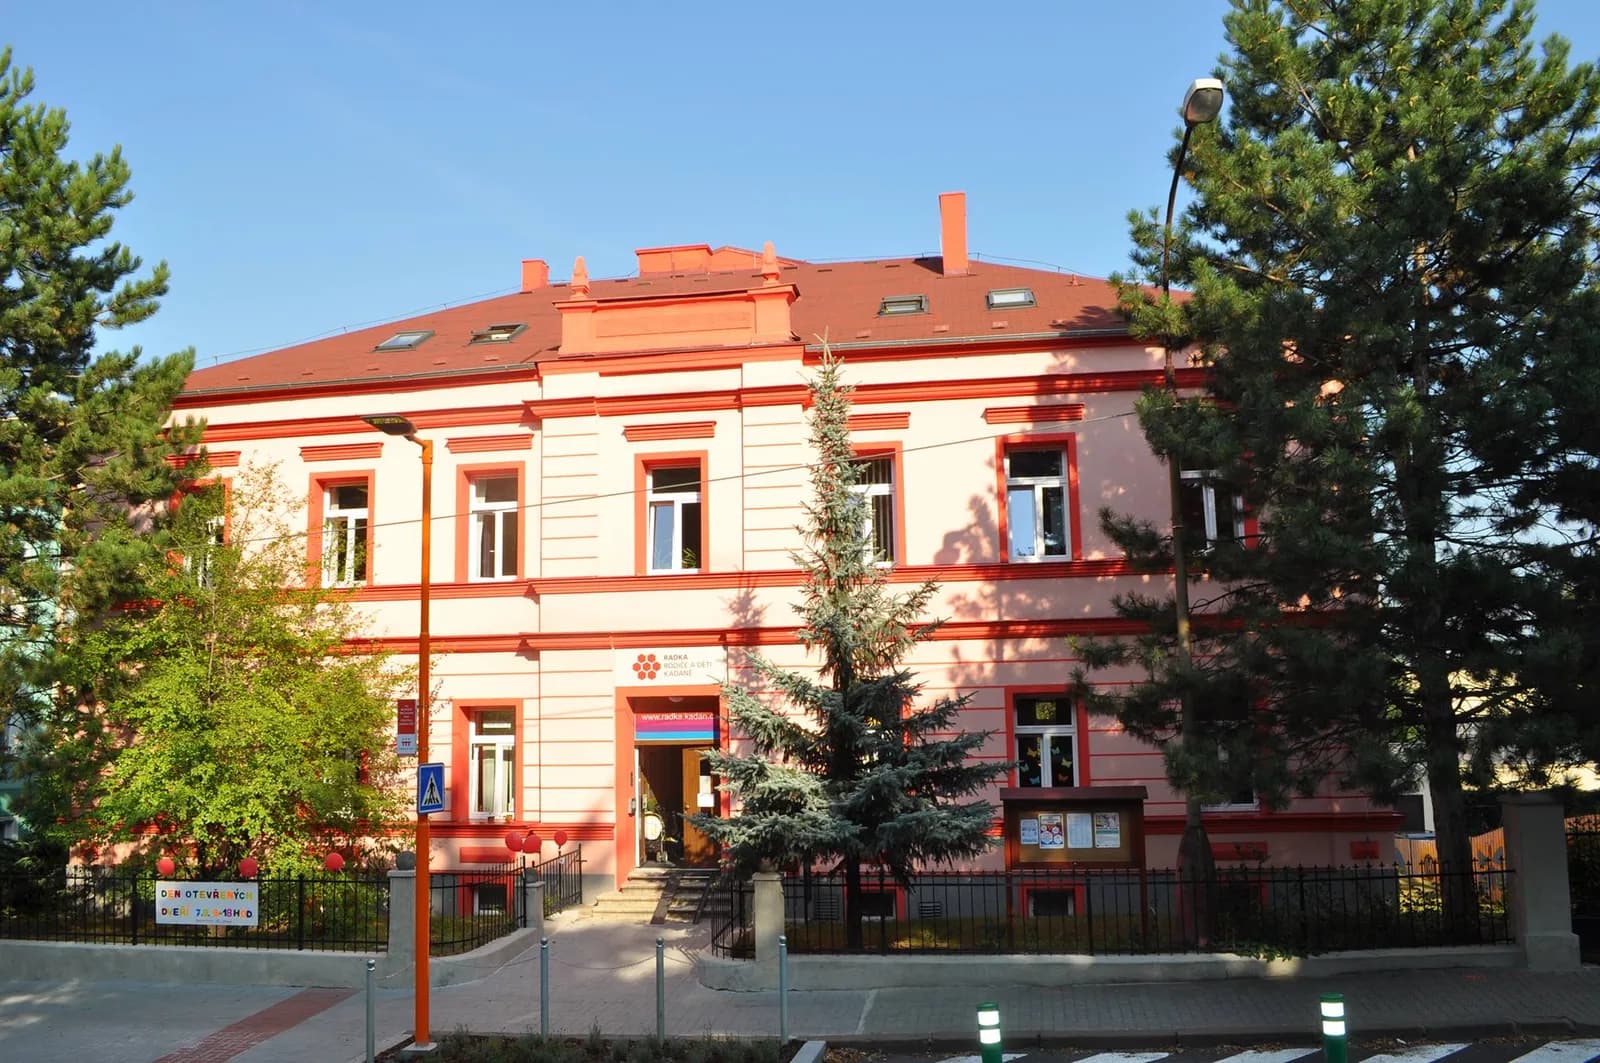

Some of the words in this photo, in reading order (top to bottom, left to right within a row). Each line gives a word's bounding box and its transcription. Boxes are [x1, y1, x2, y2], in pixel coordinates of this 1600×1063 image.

[641, 712, 719, 720] www.radka.kadan.c
[161, 889, 181, 898] DEN
[185, 888, 253, 900] OTEVŘENÝCH
